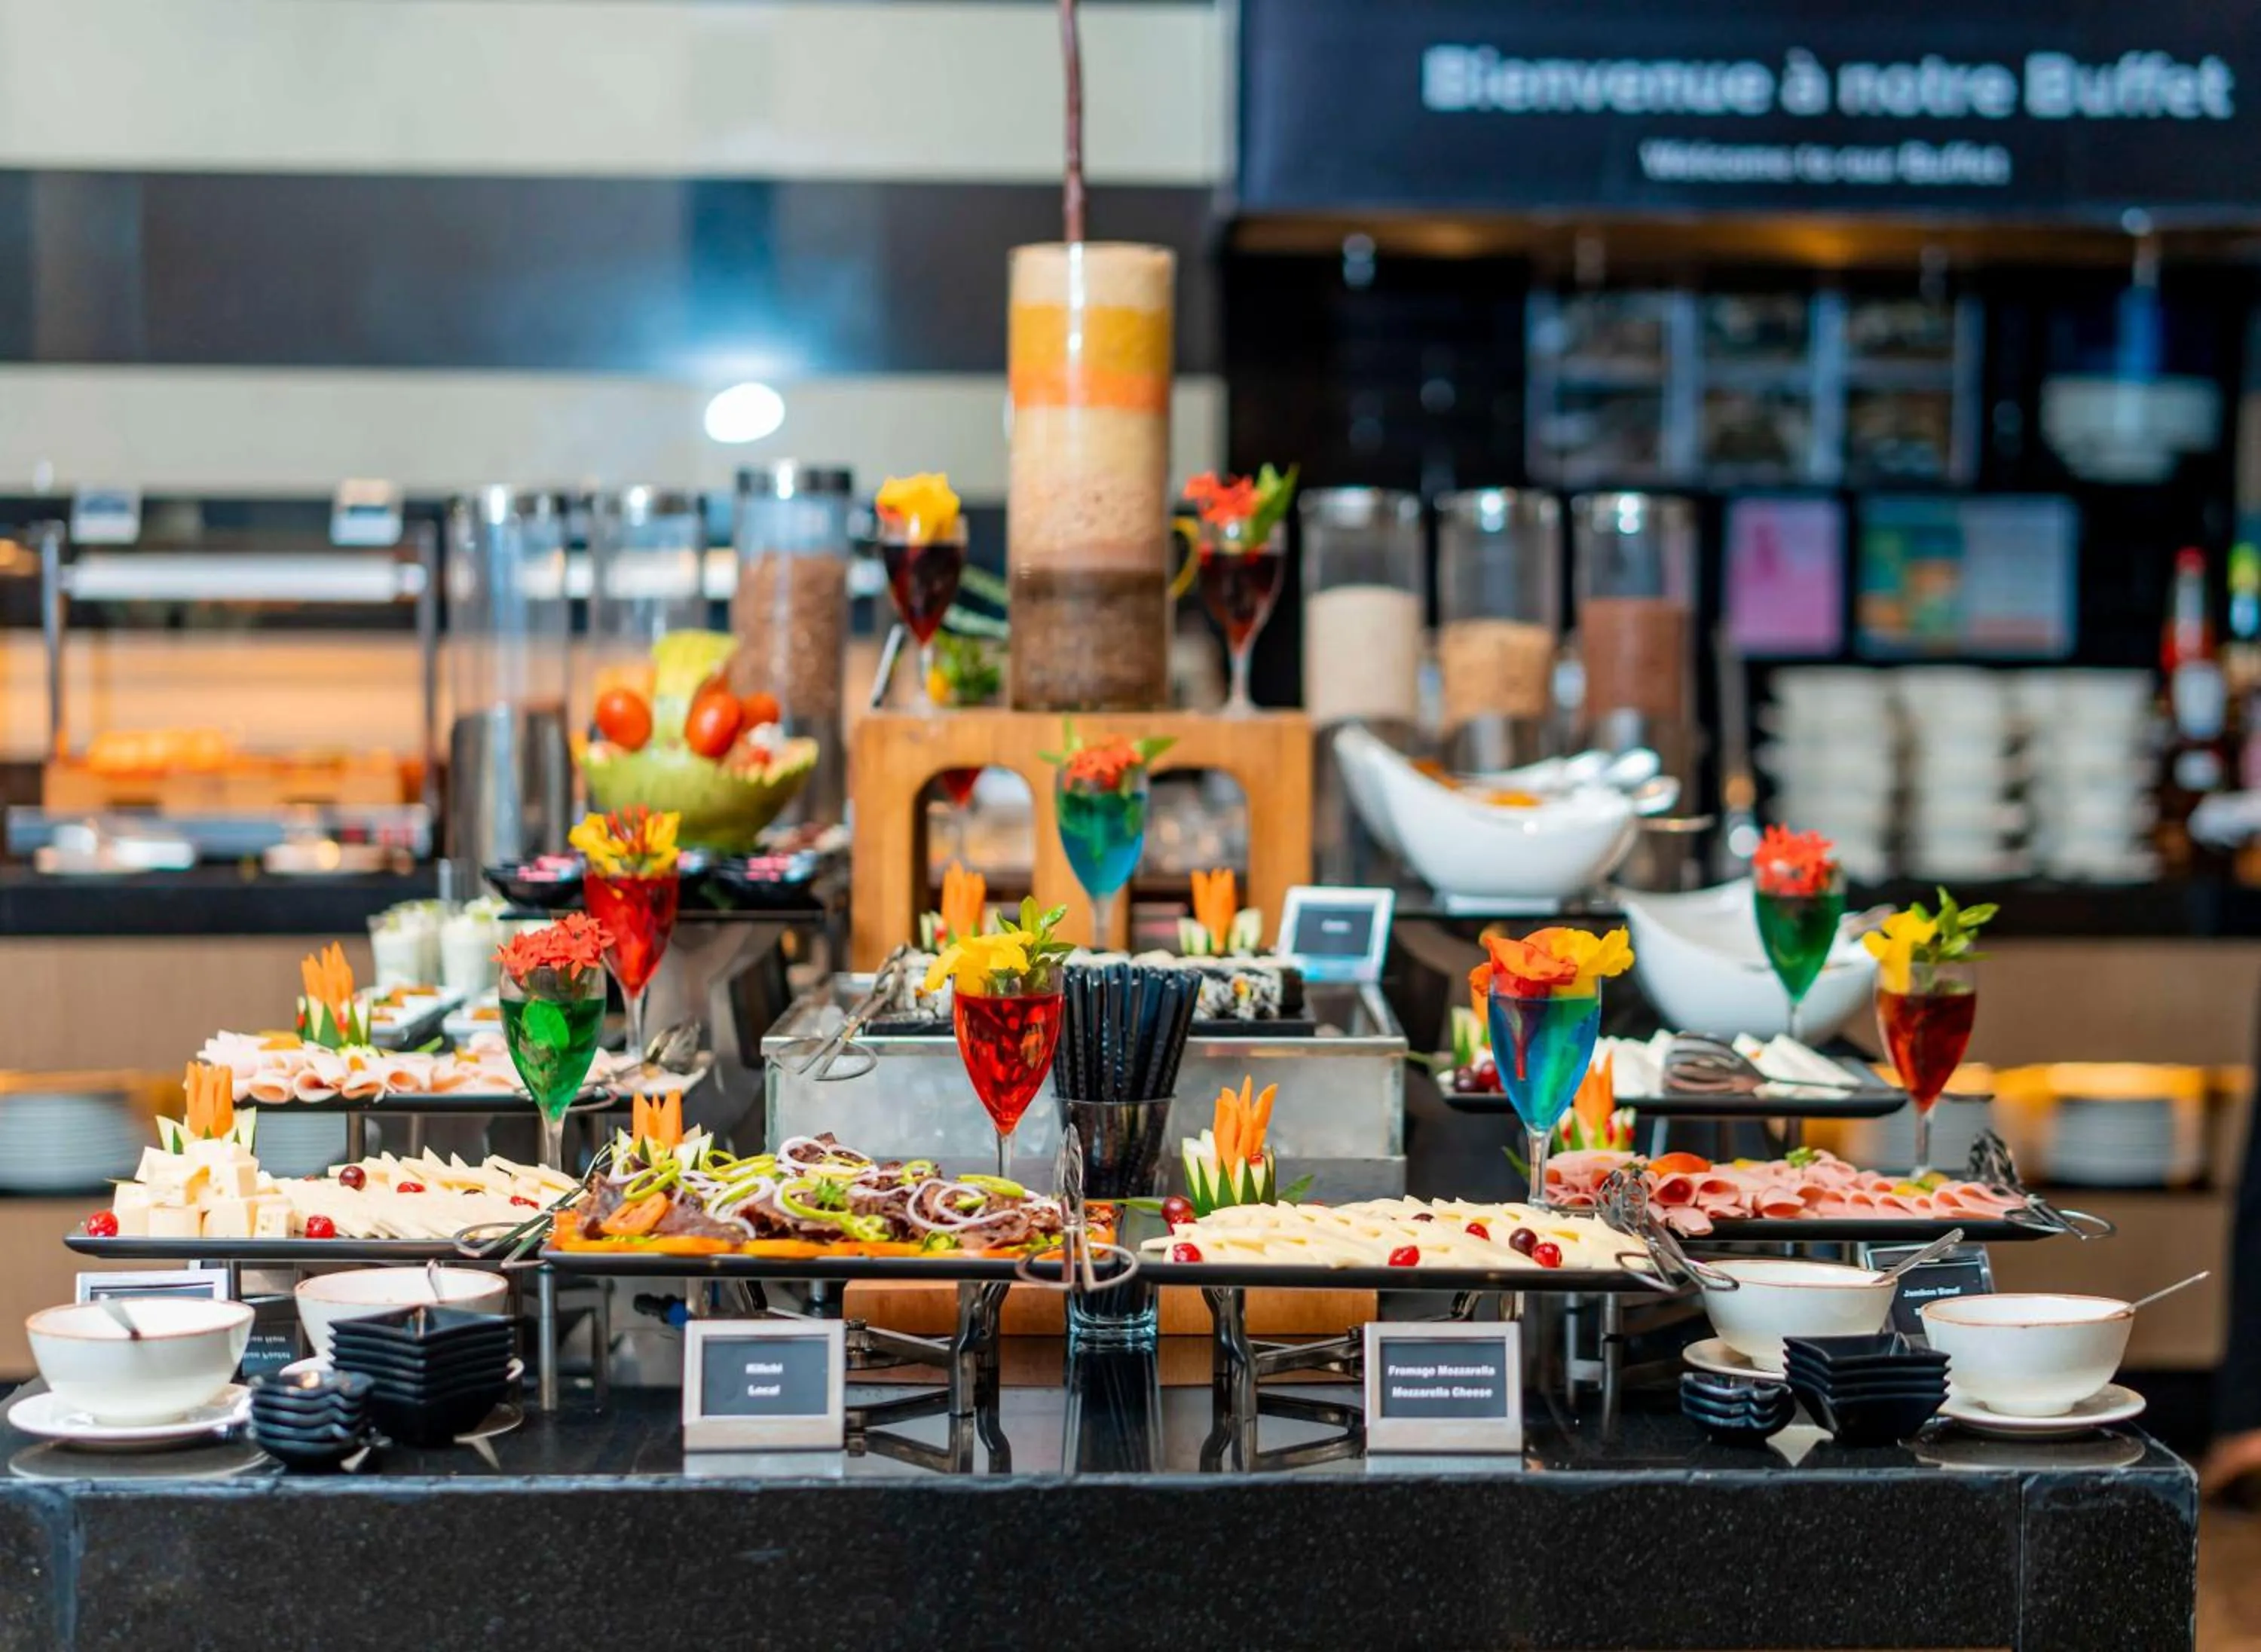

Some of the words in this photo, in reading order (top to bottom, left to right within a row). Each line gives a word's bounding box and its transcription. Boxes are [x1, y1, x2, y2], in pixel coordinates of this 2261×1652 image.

[1423, 45, 1773, 112] Bienvenue
[1781, 48, 1828, 115] à
[1837, 54, 2015, 116] notre
[2024, 50, 2232, 118] Buffet
[1388, 1365, 1436, 1378] Fromage
[1437, 1365, 1496, 1376] Mozzarella
[1392, 1386, 1449, 1397] Mozzarella
[1452, 1386, 1493, 1397] Cheese
